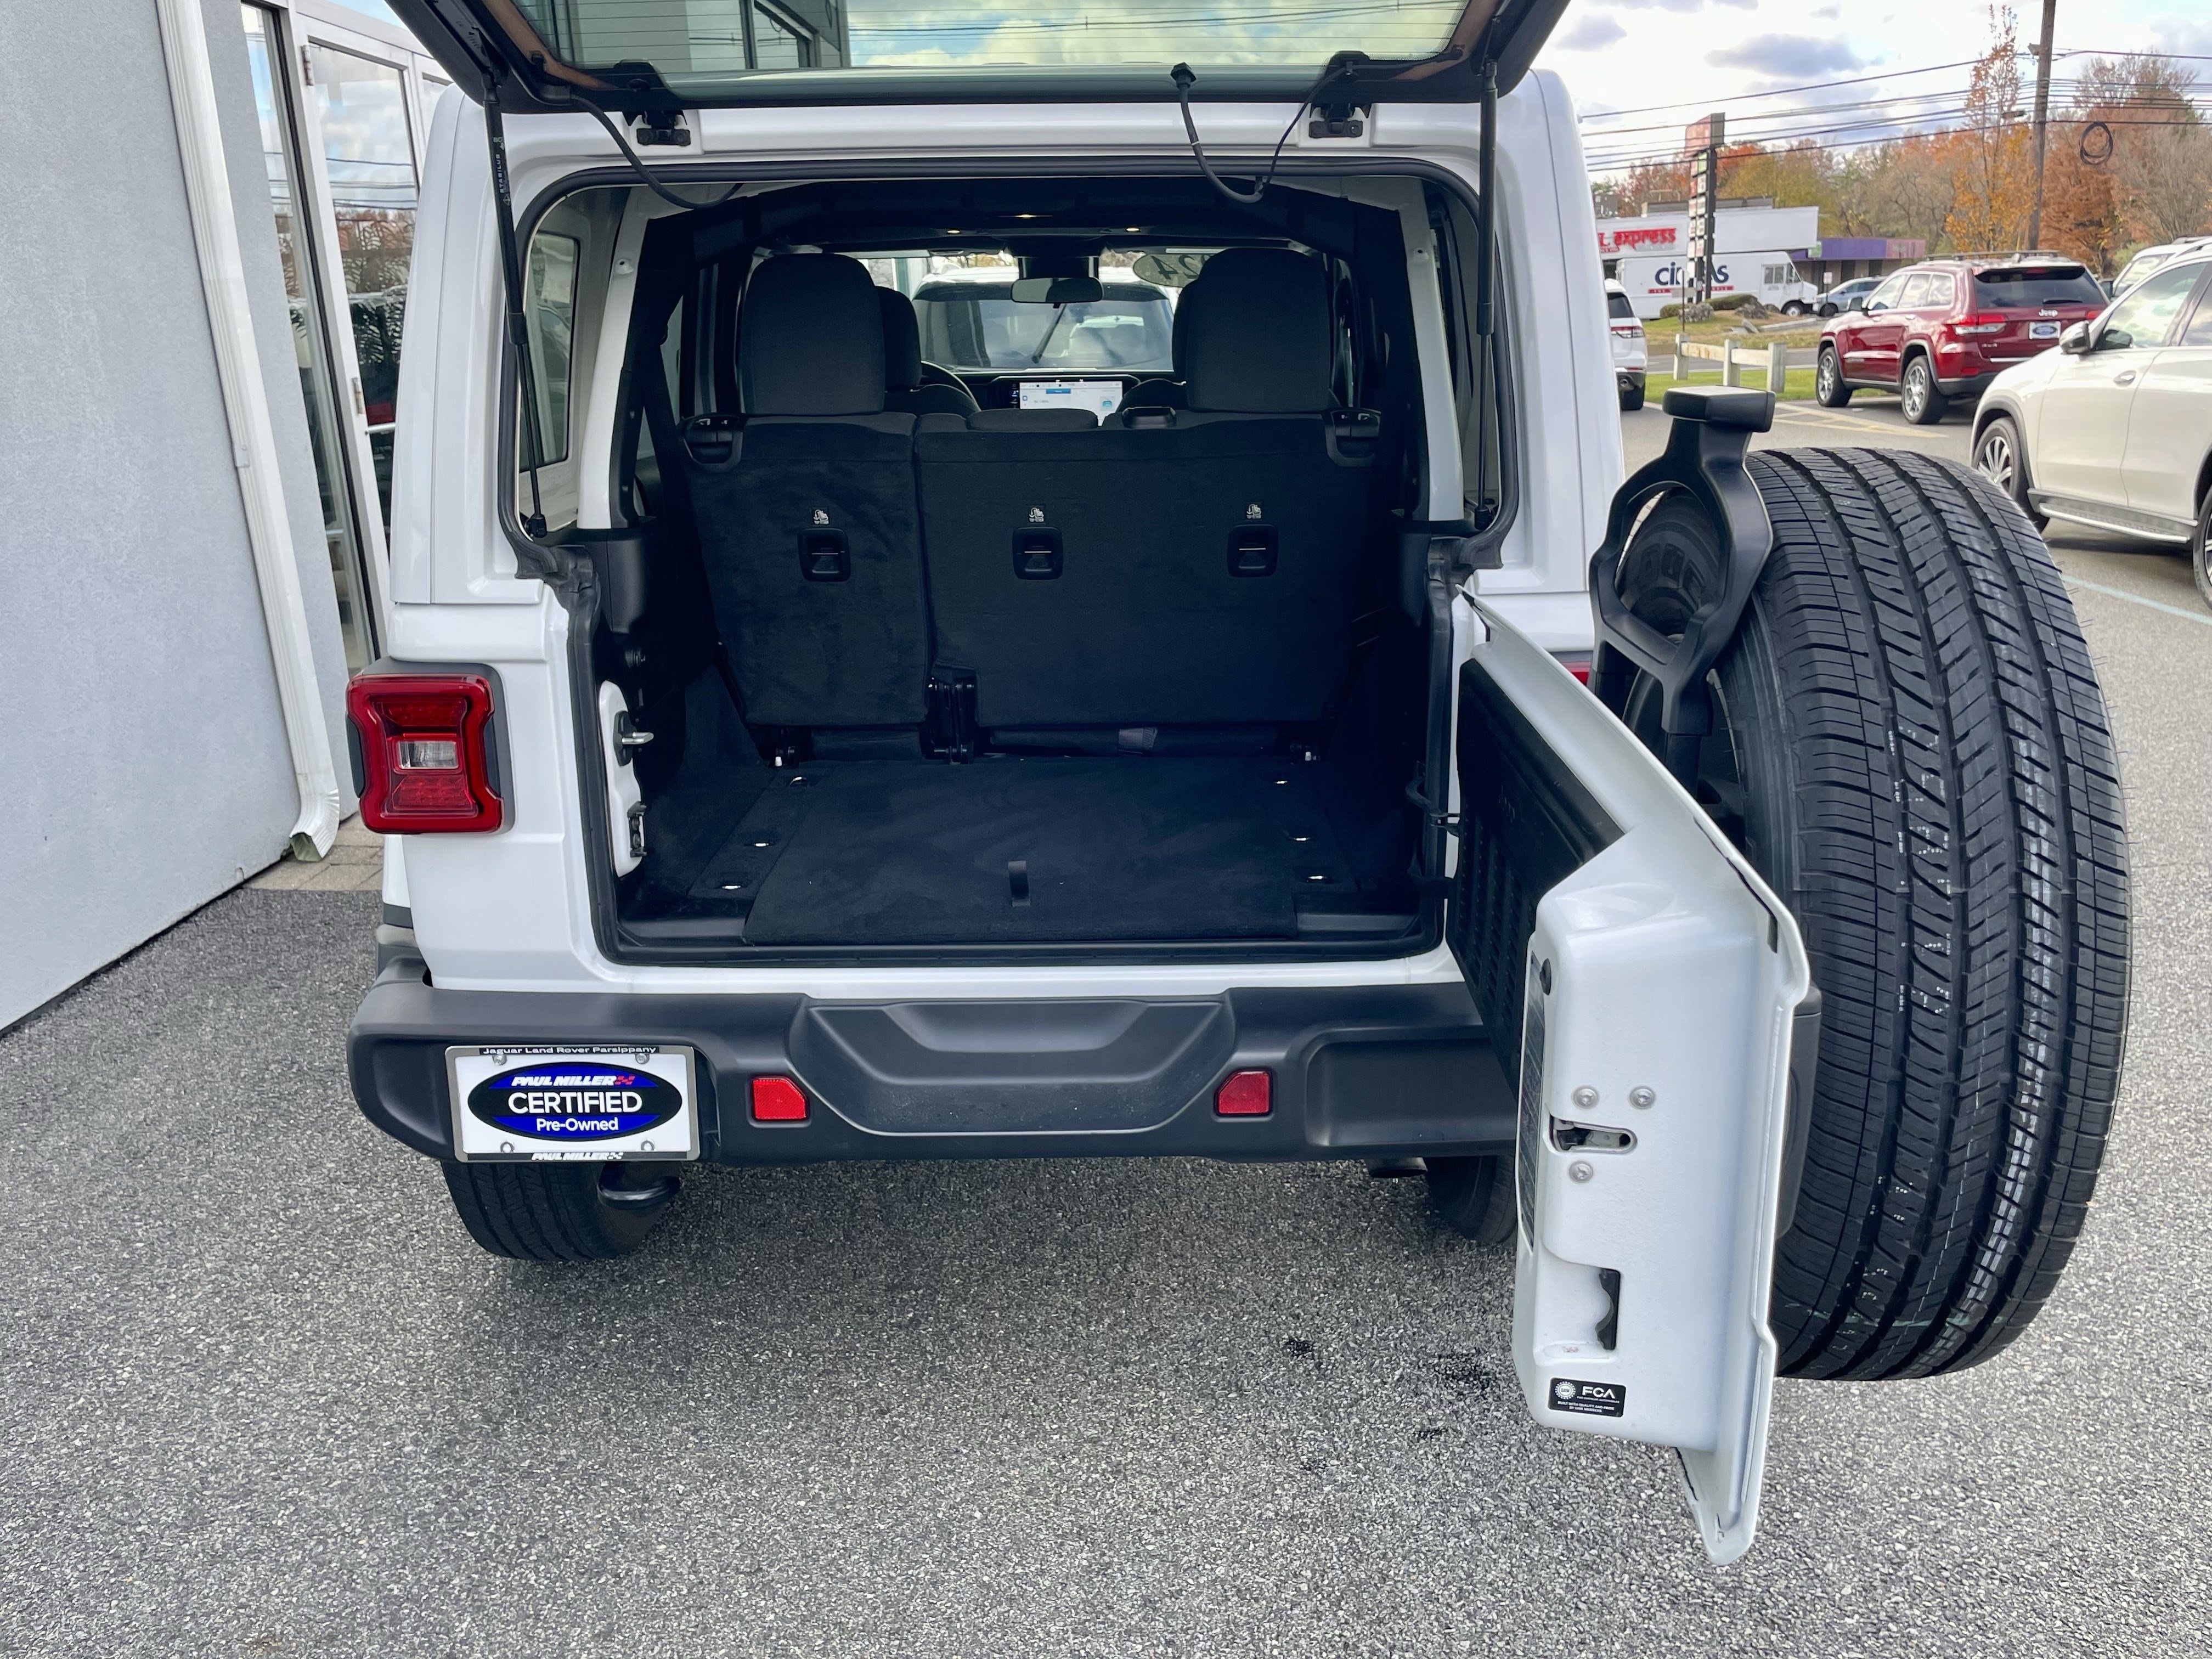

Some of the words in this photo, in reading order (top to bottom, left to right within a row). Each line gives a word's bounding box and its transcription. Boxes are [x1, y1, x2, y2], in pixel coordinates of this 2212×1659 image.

[1613, 228, 1677, 250] express
[511, 1075, 553, 1087] PAUL
[553, 1075, 617, 1086] MILLER
[508, 1091, 642, 1114] CERTIFIED
[536, 1117, 619, 1132] Pre-Owned
[532, 1152, 562, 1160] PAUL
[562, 1152, 610, 1160] MILLER
[1582, 1385, 1616, 1399] FCA
